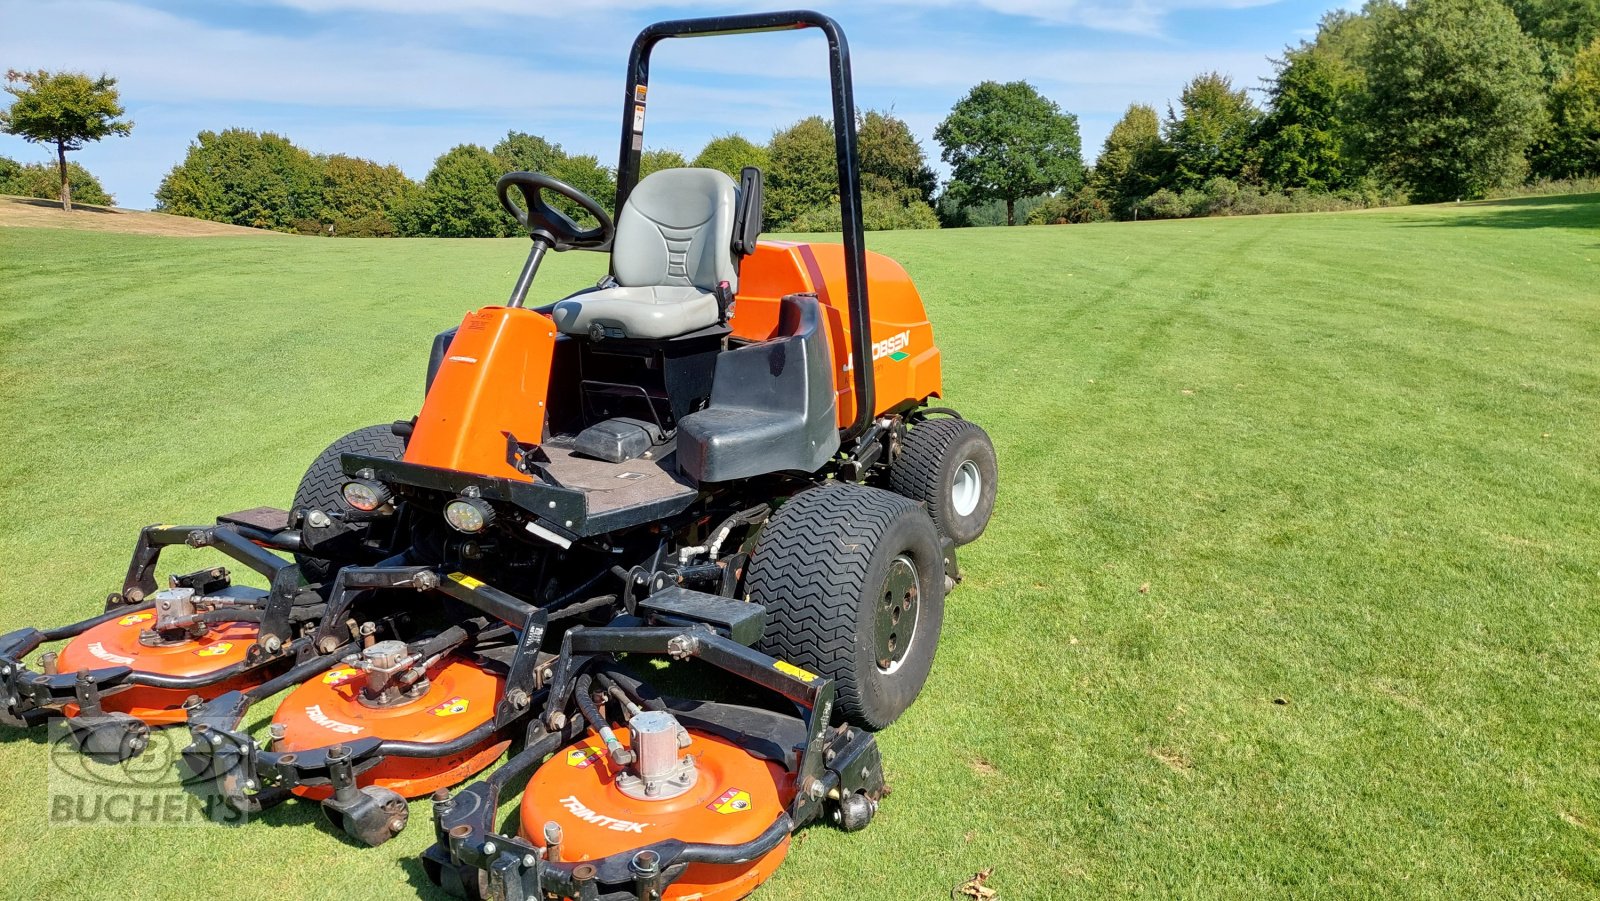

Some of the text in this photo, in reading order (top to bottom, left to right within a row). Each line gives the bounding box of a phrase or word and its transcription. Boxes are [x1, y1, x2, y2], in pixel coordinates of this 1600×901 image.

[843, 330, 910, 372] JOBSEN
[88, 642, 135, 664] TRIMTEK
[305, 705, 364, 734] TRIMTEK
[559, 796, 650, 833] TRIMTEK
